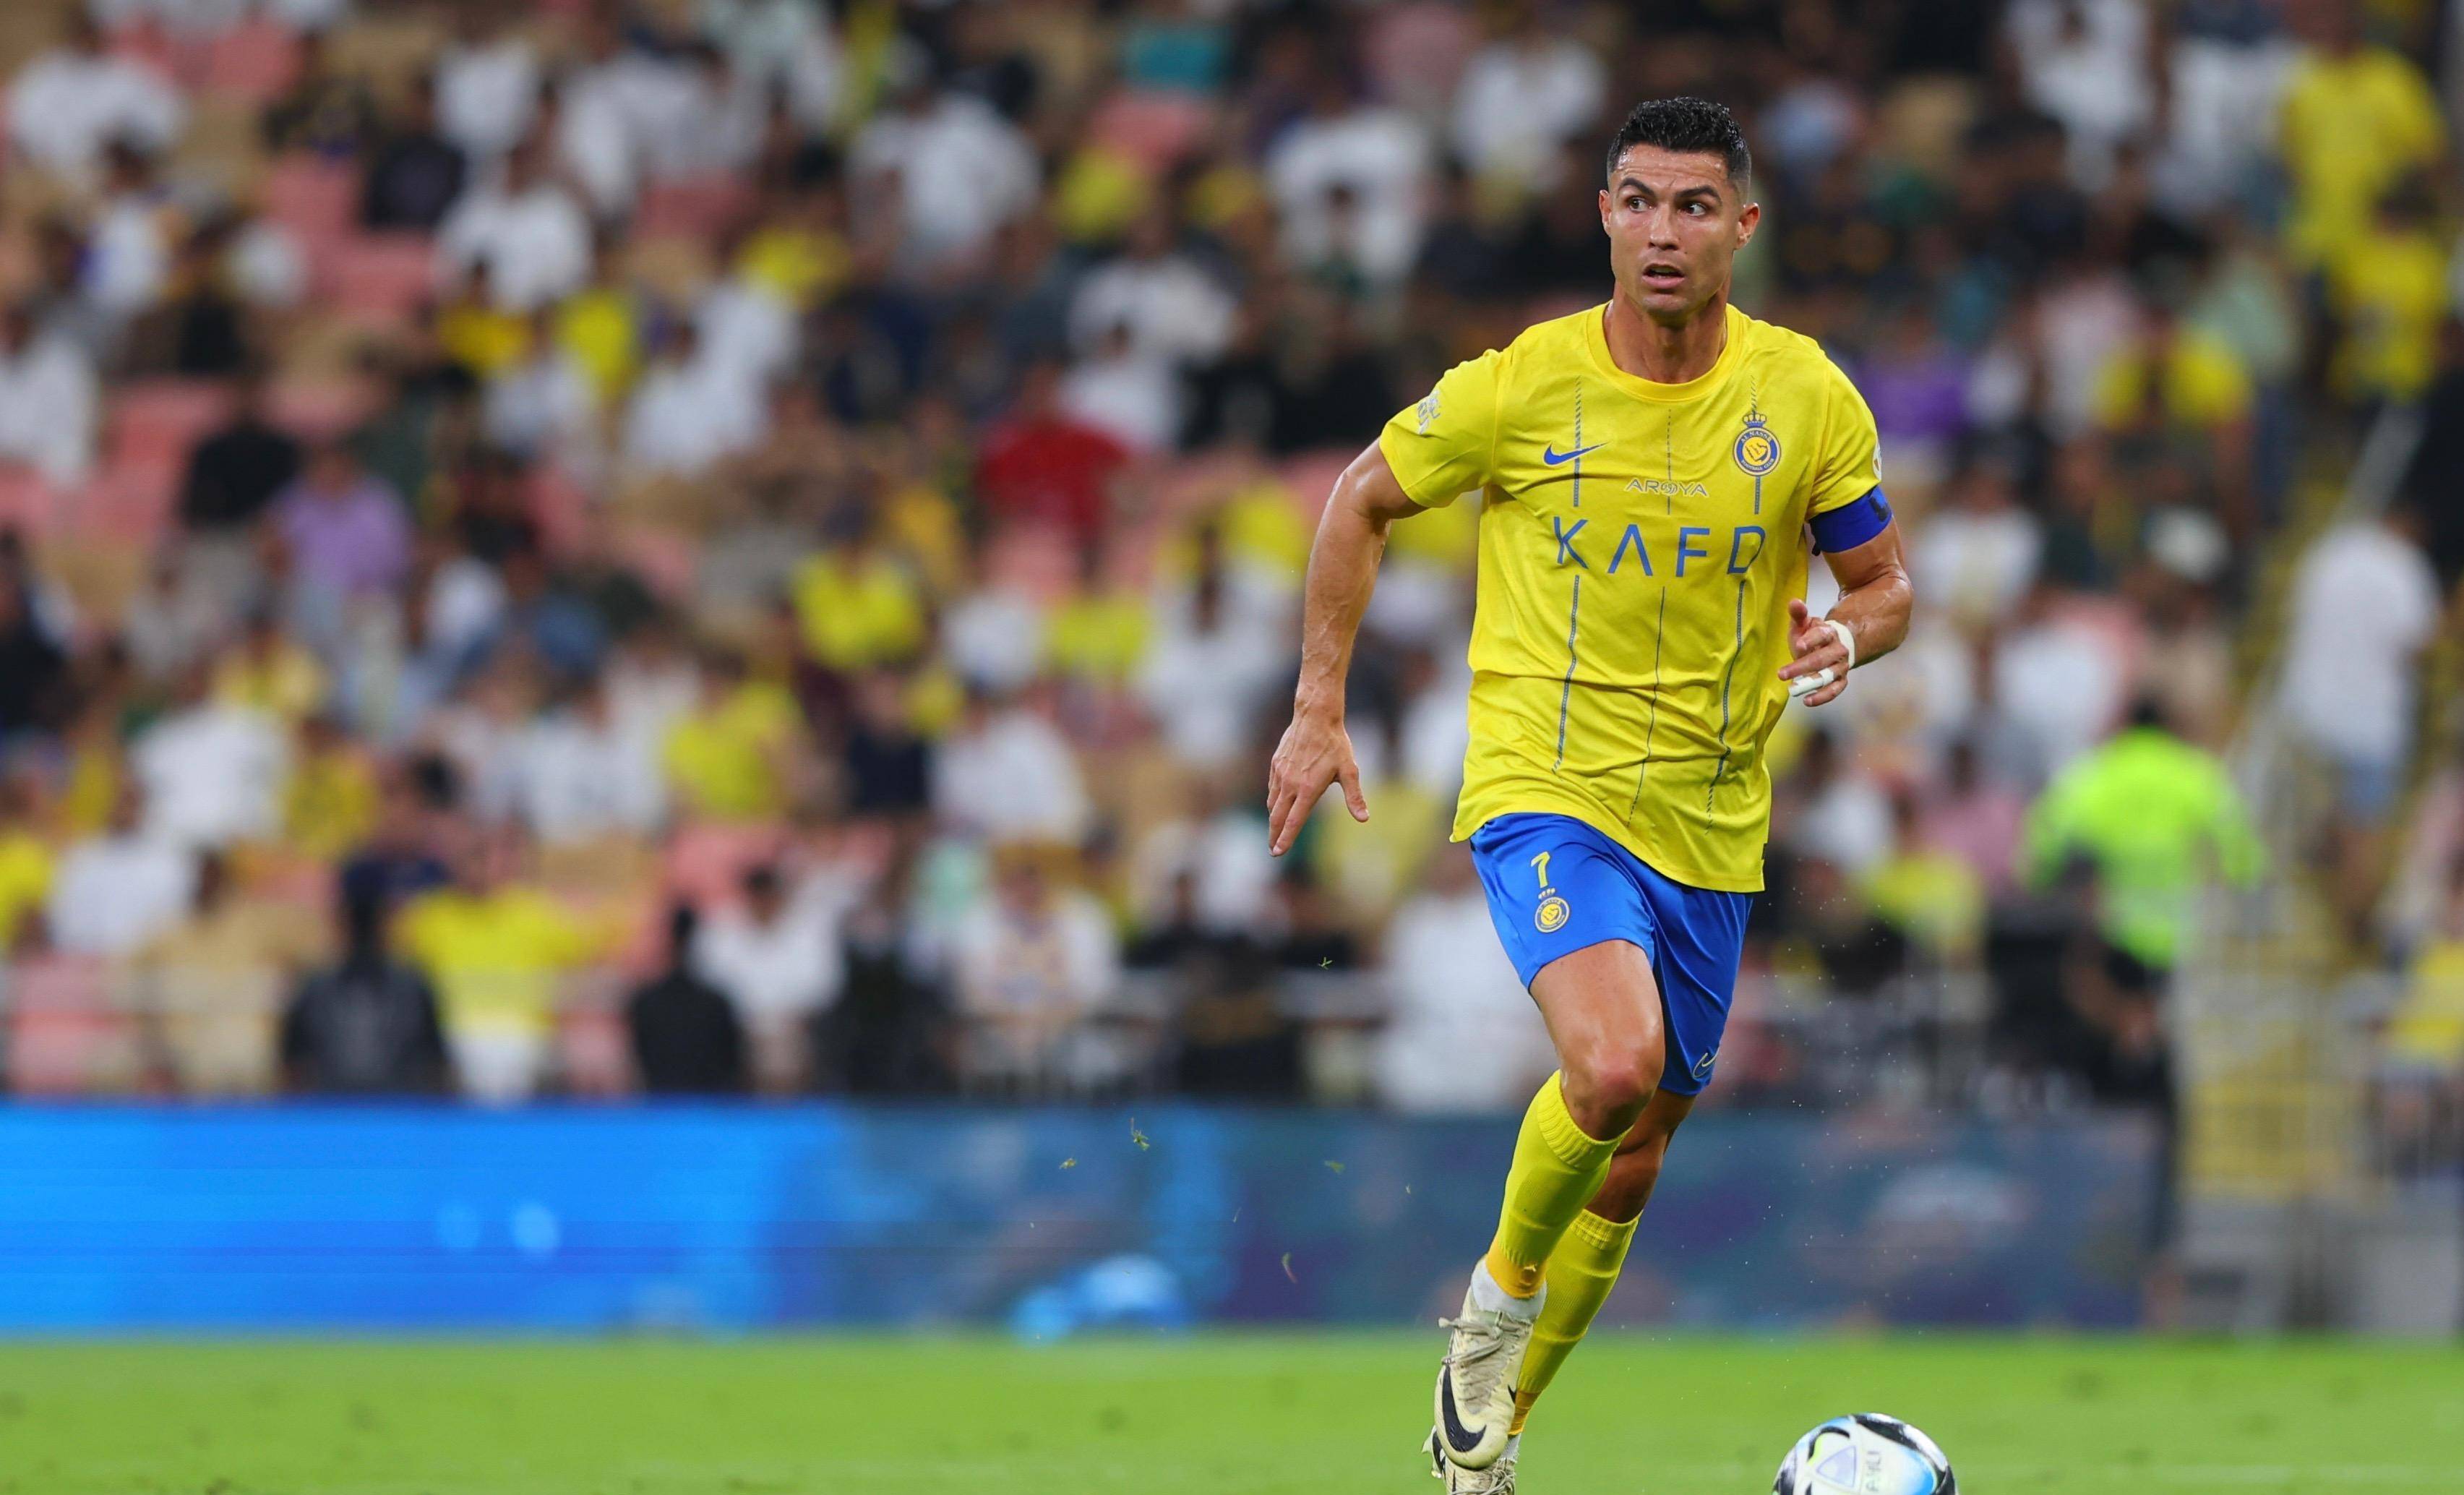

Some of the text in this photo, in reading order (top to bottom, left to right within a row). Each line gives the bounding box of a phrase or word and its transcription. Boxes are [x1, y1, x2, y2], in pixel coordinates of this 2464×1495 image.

[1624, 478, 1709, 497] AROYA
[1554, 516, 1766, 577] KAFD
[1531, 851, 1550, 888] 7
